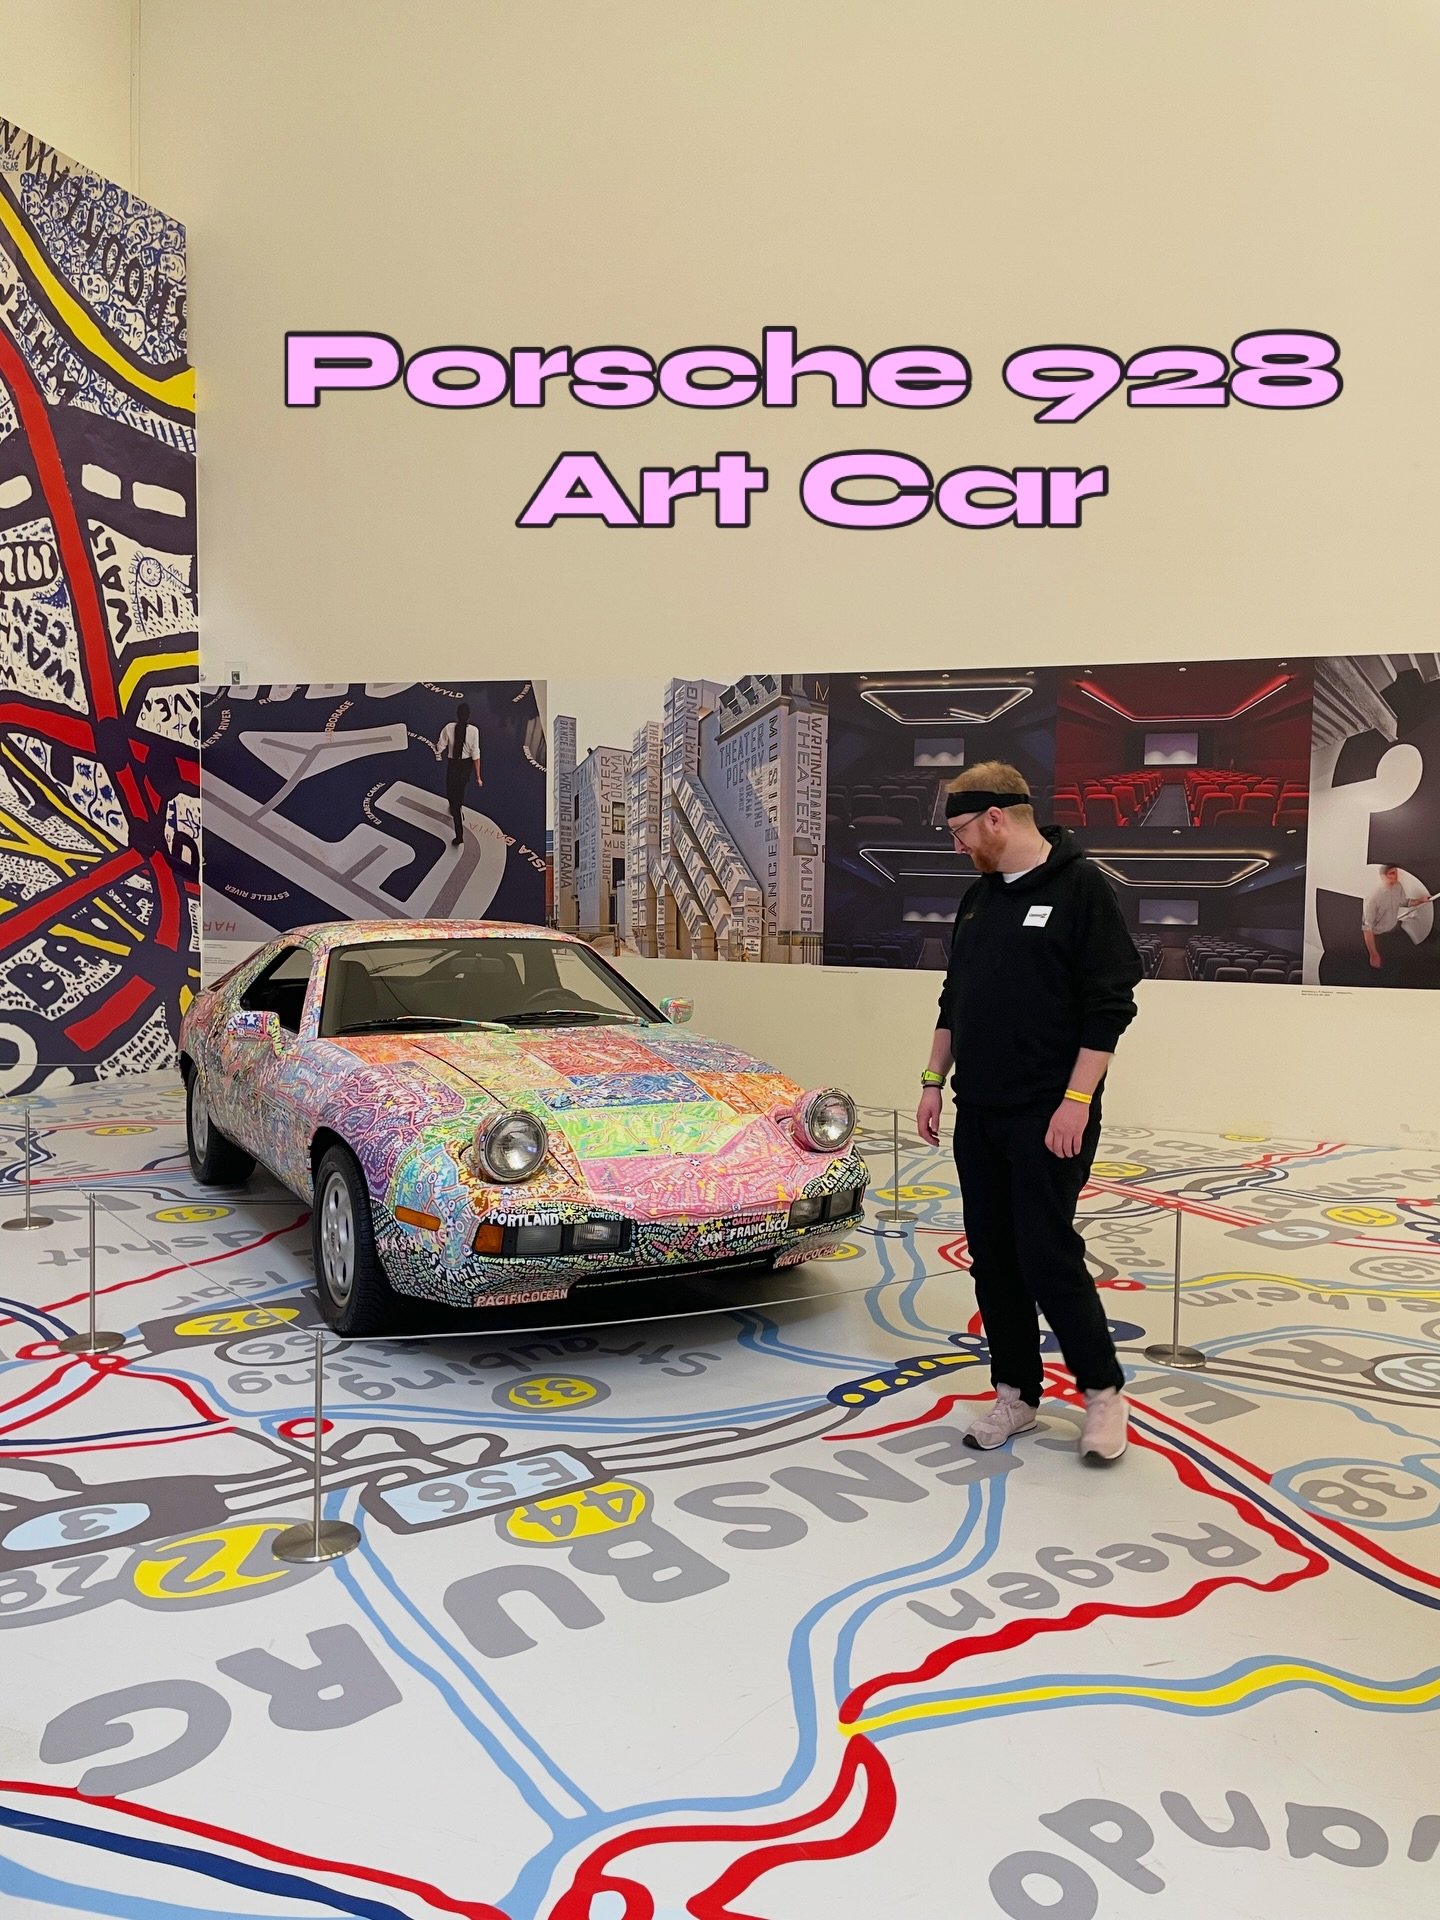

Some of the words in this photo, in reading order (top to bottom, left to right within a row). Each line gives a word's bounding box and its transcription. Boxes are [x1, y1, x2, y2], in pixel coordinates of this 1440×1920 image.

[795, 715, 811, 834] THEATER
[600, 755, 611, 839] THEATER
[224, 884, 249, 898] RIVER
[249, 890, 290, 902] ESTELLE
[800, 856, 814, 932] MUSIC
[489, 1211, 560, 1228] PORTLAND
[696, 1231, 724, 1247] SAN
[729, 1219, 790, 1241] FRANCISCO
[731, 1213, 766, 1226] OAKLAND
[512, 1377, 589, 1410] 33
[516, 1487, 637, 1539] 44
[1297, 1468, 1428, 1519] 38
[58, 1507, 118, 1541] 3
[907, 1522, 1262, 1631] Regen
